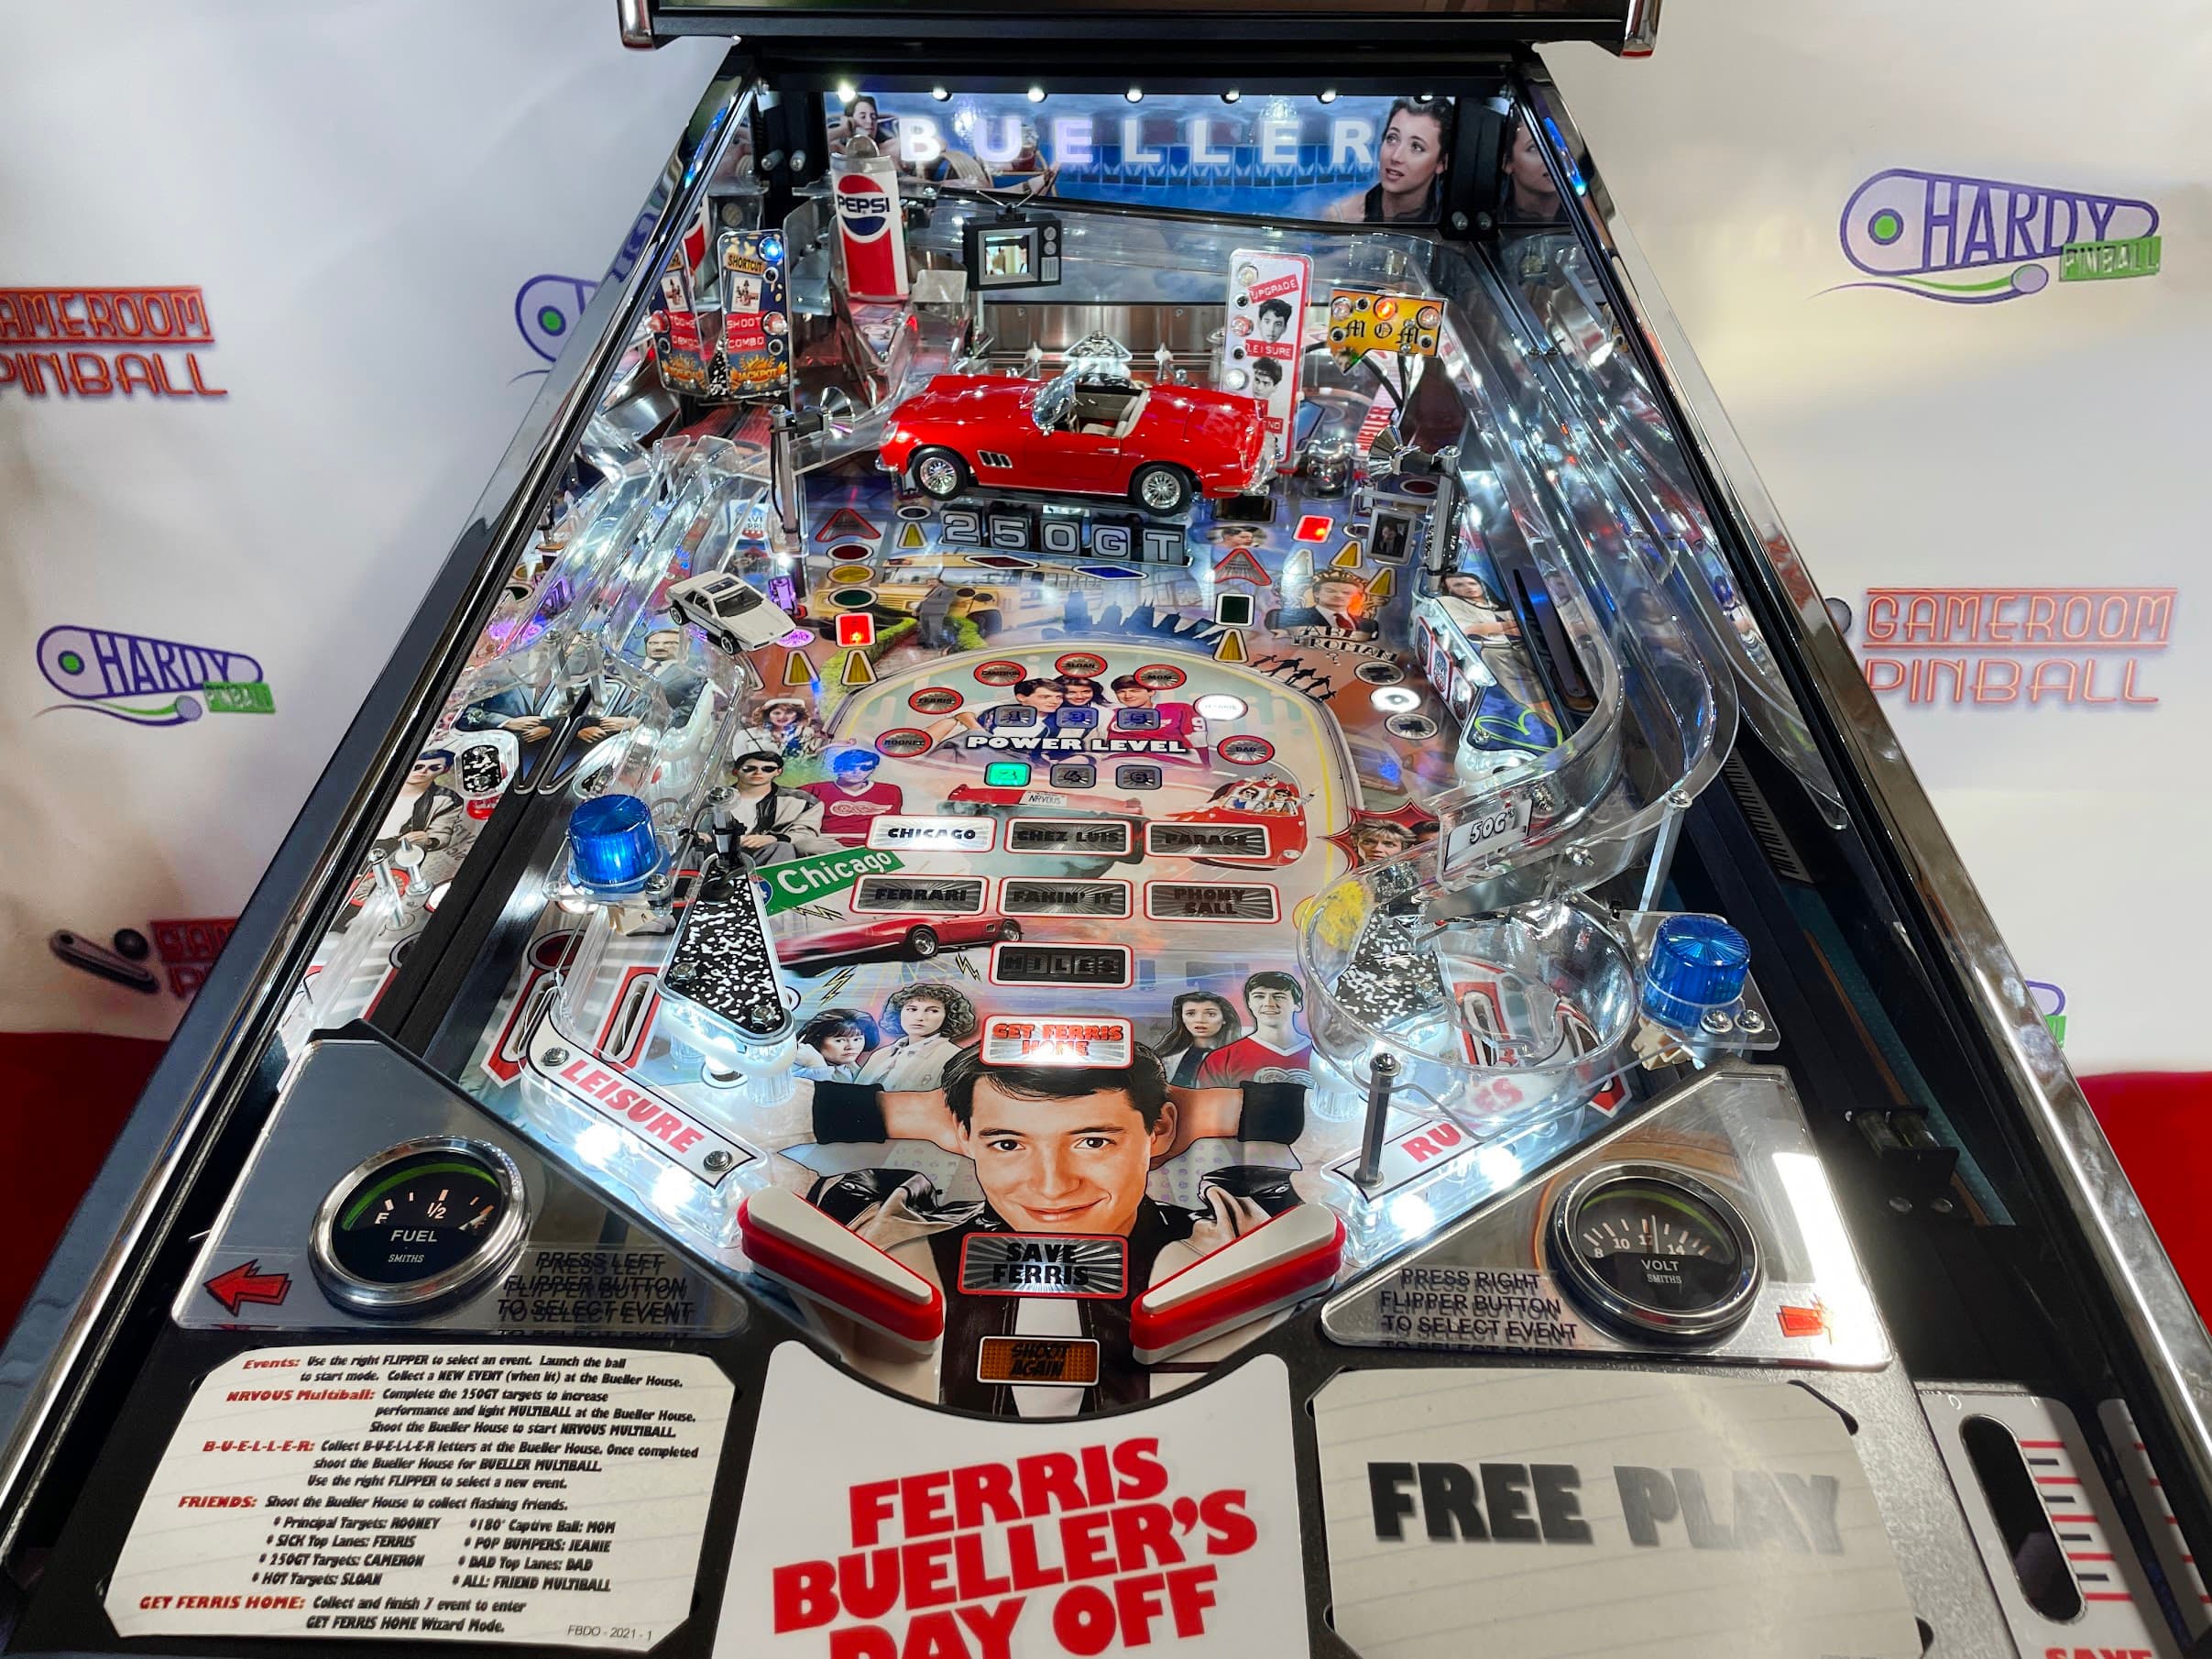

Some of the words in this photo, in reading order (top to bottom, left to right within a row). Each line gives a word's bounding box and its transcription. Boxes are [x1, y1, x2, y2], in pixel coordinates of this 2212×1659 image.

[899, 116, 1373, 164] BUELLER
[838, 196, 890, 214] PEPSI
[1921, 176, 2117, 269] HARDY
[728, 254, 762, 272] SHORTCUT
[2064, 243, 2159, 273] PINBALL
[1251, 280, 1297, 299] UPGRADE
[0, 293, 210, 336] AMEROOM
[727, 317, 761, 329] SHOOT
[728, 335, 764, 348] COMBO
[1247, 343, 1291, 357] LEISURE
[0, 351, 227, 394] PINBALL
[738, 368, 779, 380] JACKPOT
[945, 514, 1180, 561] 250GT
[1869, 596, 2177, 640] GAMEROOM
[89, 630, 229, 697] HARDY
[1865, 658, 2159, 703] PINBALL
[1070, 712, 1085, 722] 3
[1192, 718, 1204, 732] 9
[967, 736, 1082, 751] POWER
[1091, 739, 1188, 753] LEVEL
[1029, 795, 1060, 806] NRVOUS
[887, 828, 976, 840] CHICAGO
[1017, 830, 1068, 842] CHEZ
[1076, 831, 1120, 843] LUIS
[1166, 833, 1248, 846] PARADE
[777, 852, 892, 894] Chicago
[874, 888, 967, 901] FERRARI
[1174, 888, 1246, 902] PHONY
[1184, 902, 1238, 915] CALL
[1005, 955, 1119, 975] MILES
[992, 1024, 1034, 1038] GET
[1043, 1025, 1123, 1040] FERRIS
[1022, 1040, 1089, 1056] HOME
[560, 1059, 705, 1153] LEISURE
[375, 1213, 389, 1225] F
[427, 1202, 447, 1219] 1/2
[390, 1230, 437, 1242] FUEL
[1614, 1238, 1630, 1250] 10
[388, 1254, 424, 1263] SMITHS
[1006, 1243, 1078, 1263] SAVE
[1594, 1247, 1604, 1258] 8
[1668, 1245, 1686, 1256] 14
[536, 1252, 608, 1269] PRESS
[611, 1253, 665, 1269] LEFT
[1641, 1259, 1680, 1271] VOLT
[993, 1264, 1090, 1286] FERRIS
[1401, 1269, 1471, 1285] PRESS
[1475, 1271, 1539, 1289] RIGHT
[1647, 1274, 1682, 1283] SMITHS
[503, 1275, 594, 1292] FLIPPER
[598, 1277, 687, 1293] BUTTON
[531, 1300, 616, 1316] SELECT
[620, 1301, 695, 1317] EVENT
[1381, 1291, 1468, 1311] FLIPPER
[1473, 1295, 1561, 1314] BUTTON
[1383, 1315, 1412, 1331] TO
[1418, 1316, 1500, 1335] SELECT
[1507, 1321, 1578, 1339] EVENT
[1012, 1342, 1071, 1359] SHOOT
[242, 1358, 301, 1369] Events:
[307, 1357, 326, 1366] Use
[330, 1356, 348, 1366] the
[350, 1355, 380, 1368] right
[381, 1355, 429, 1366] FLIPPER
[433, 1355, 443, 1366] to
[445, 1355, 479, 1365] select
[482, 1357, 497, 1365] an
[498, 1355, 532, 1366] event.
[539, 1355, 579, 1367] Launch
[583, 1357, 601, 1368] the
[604, 1357, 627, 1368] ball
[1010, 1358, 1067, 1375] AGAIN
[301, 1372, 312, 1382] to
[313, 1371, 344, 1381] start
[345, 1370, 379, 1381] mode.
[387, 1370, 425, 1381] Collect
[427, 1372, 434, 1380] a
[437, 1370, 465, 1381] NEW
[466, 1370, 504, 1381] EVENT
[506, 1369, 541, 1383] (when
[542, 1371, 561, 1384] lit)
[564, 1373, 576, 1382] at
[579, 1372, 597, 1384] the
[601, 1373, 643, 1385] Bueller
[645, 1375, 683, 1388] House.
[225, 1390, 293, 1401] NRVOUS
[295, 1390, 376, 1401] Multiball:
[383, 1388, 435, 1401] Complete
[439, 1388, 457, 1399] the
[461, 1388, 500, 1400] 250GT
[502, 1389, 542, 1402] targets
[546, 1390, 558, 1401] to
[561, 1390, 608, 1402] increase
[849, 1438, 1168, 1548] FERRIS
[178, 1496, 257, 1508] FRIENDS:
[265, 1496, 300, 1508] Shoot
[302, 1496, 323, 1508] the
[324, 1496, 370, 1508] Bueller
[372, 1496, 409, 1509] House
[412, 1498, 424, 1509] to
[428, 1497, 467, 1509] collect
[470, 1497, 519, 1512] flashing
[521, 1498, 568, 1511] friends.
[1368, 1463, 1592, 1542] FREE
[1614, 1466, 1842, 1555] PLAY
[773, 1489, 1257, 1634] BUELLER'S
[139, 1596, 173, 1610] GET
[176, 1596, 242, 1610] FERRIS
[245, 1596, 306, 1610] HOME:
[313, 1596, 355, 1610] Collect
[357, 1597, 383, 1610] and
[384, 1597, 420, 1610] finish
[423, 1597, 434, 1610] 7
[437, 1599, 471, 1611] event
[476, 1599, 487, 1611] to
[491, 1600, 527, 1613] enter
[829, 1597, 1026, 1659] DAY
[1053, 1564, 1217, 1656] OFF
[306, 1615, 331, 1629] GET
[333, 1616, 378, 1629] FERRIS
[379, 1616, 419, 1630] HOME
[422, 1617, 465, 1632] Wizard
[467, 1619, 504, 1633] Mode.
[568, 1625, 600, 1636] FBDO
[610, 1628, 635, 1638] 2021
